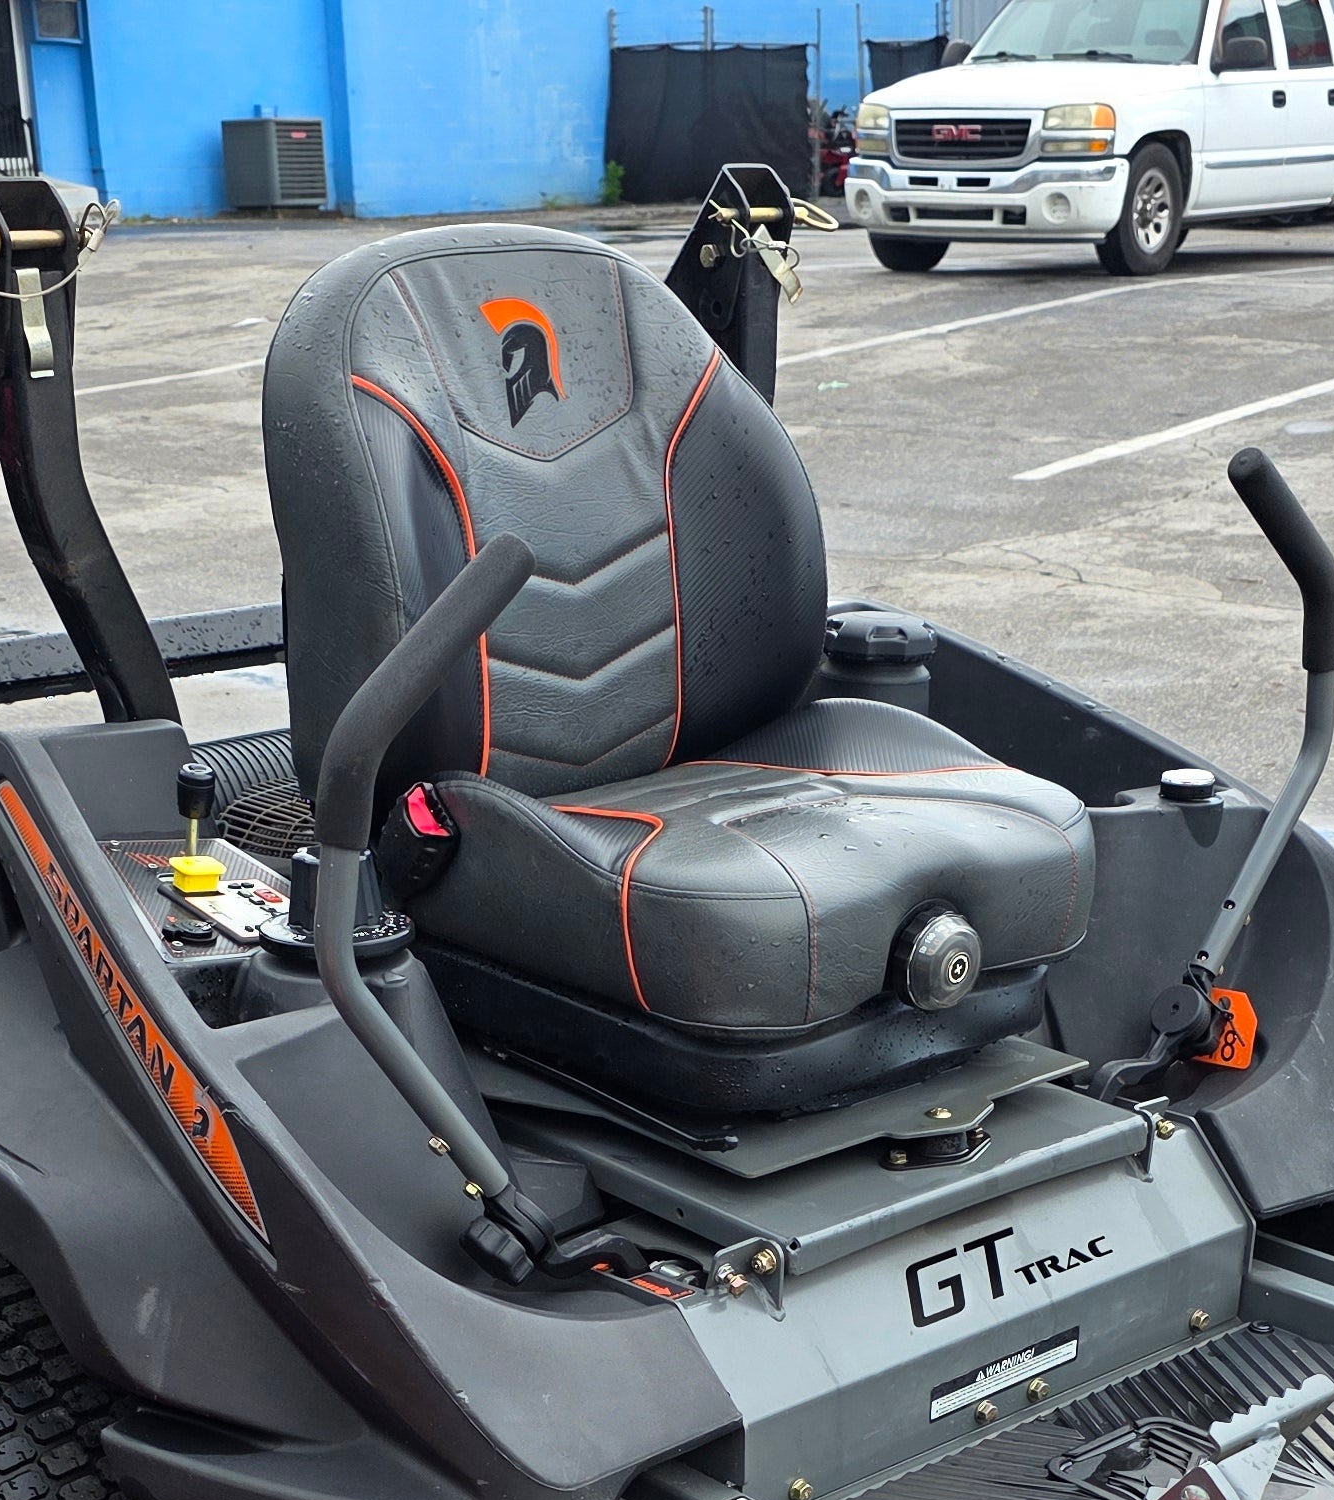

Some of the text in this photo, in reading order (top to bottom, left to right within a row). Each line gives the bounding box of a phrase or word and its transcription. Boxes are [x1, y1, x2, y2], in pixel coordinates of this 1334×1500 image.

[932, 124, 982, 141] GMC
[45, 861, 177, 1099] SPARTAN
[905, 1226, 1113, 1328] GT TRAC
[985, 1347, 1035, 1377] WARNING!
